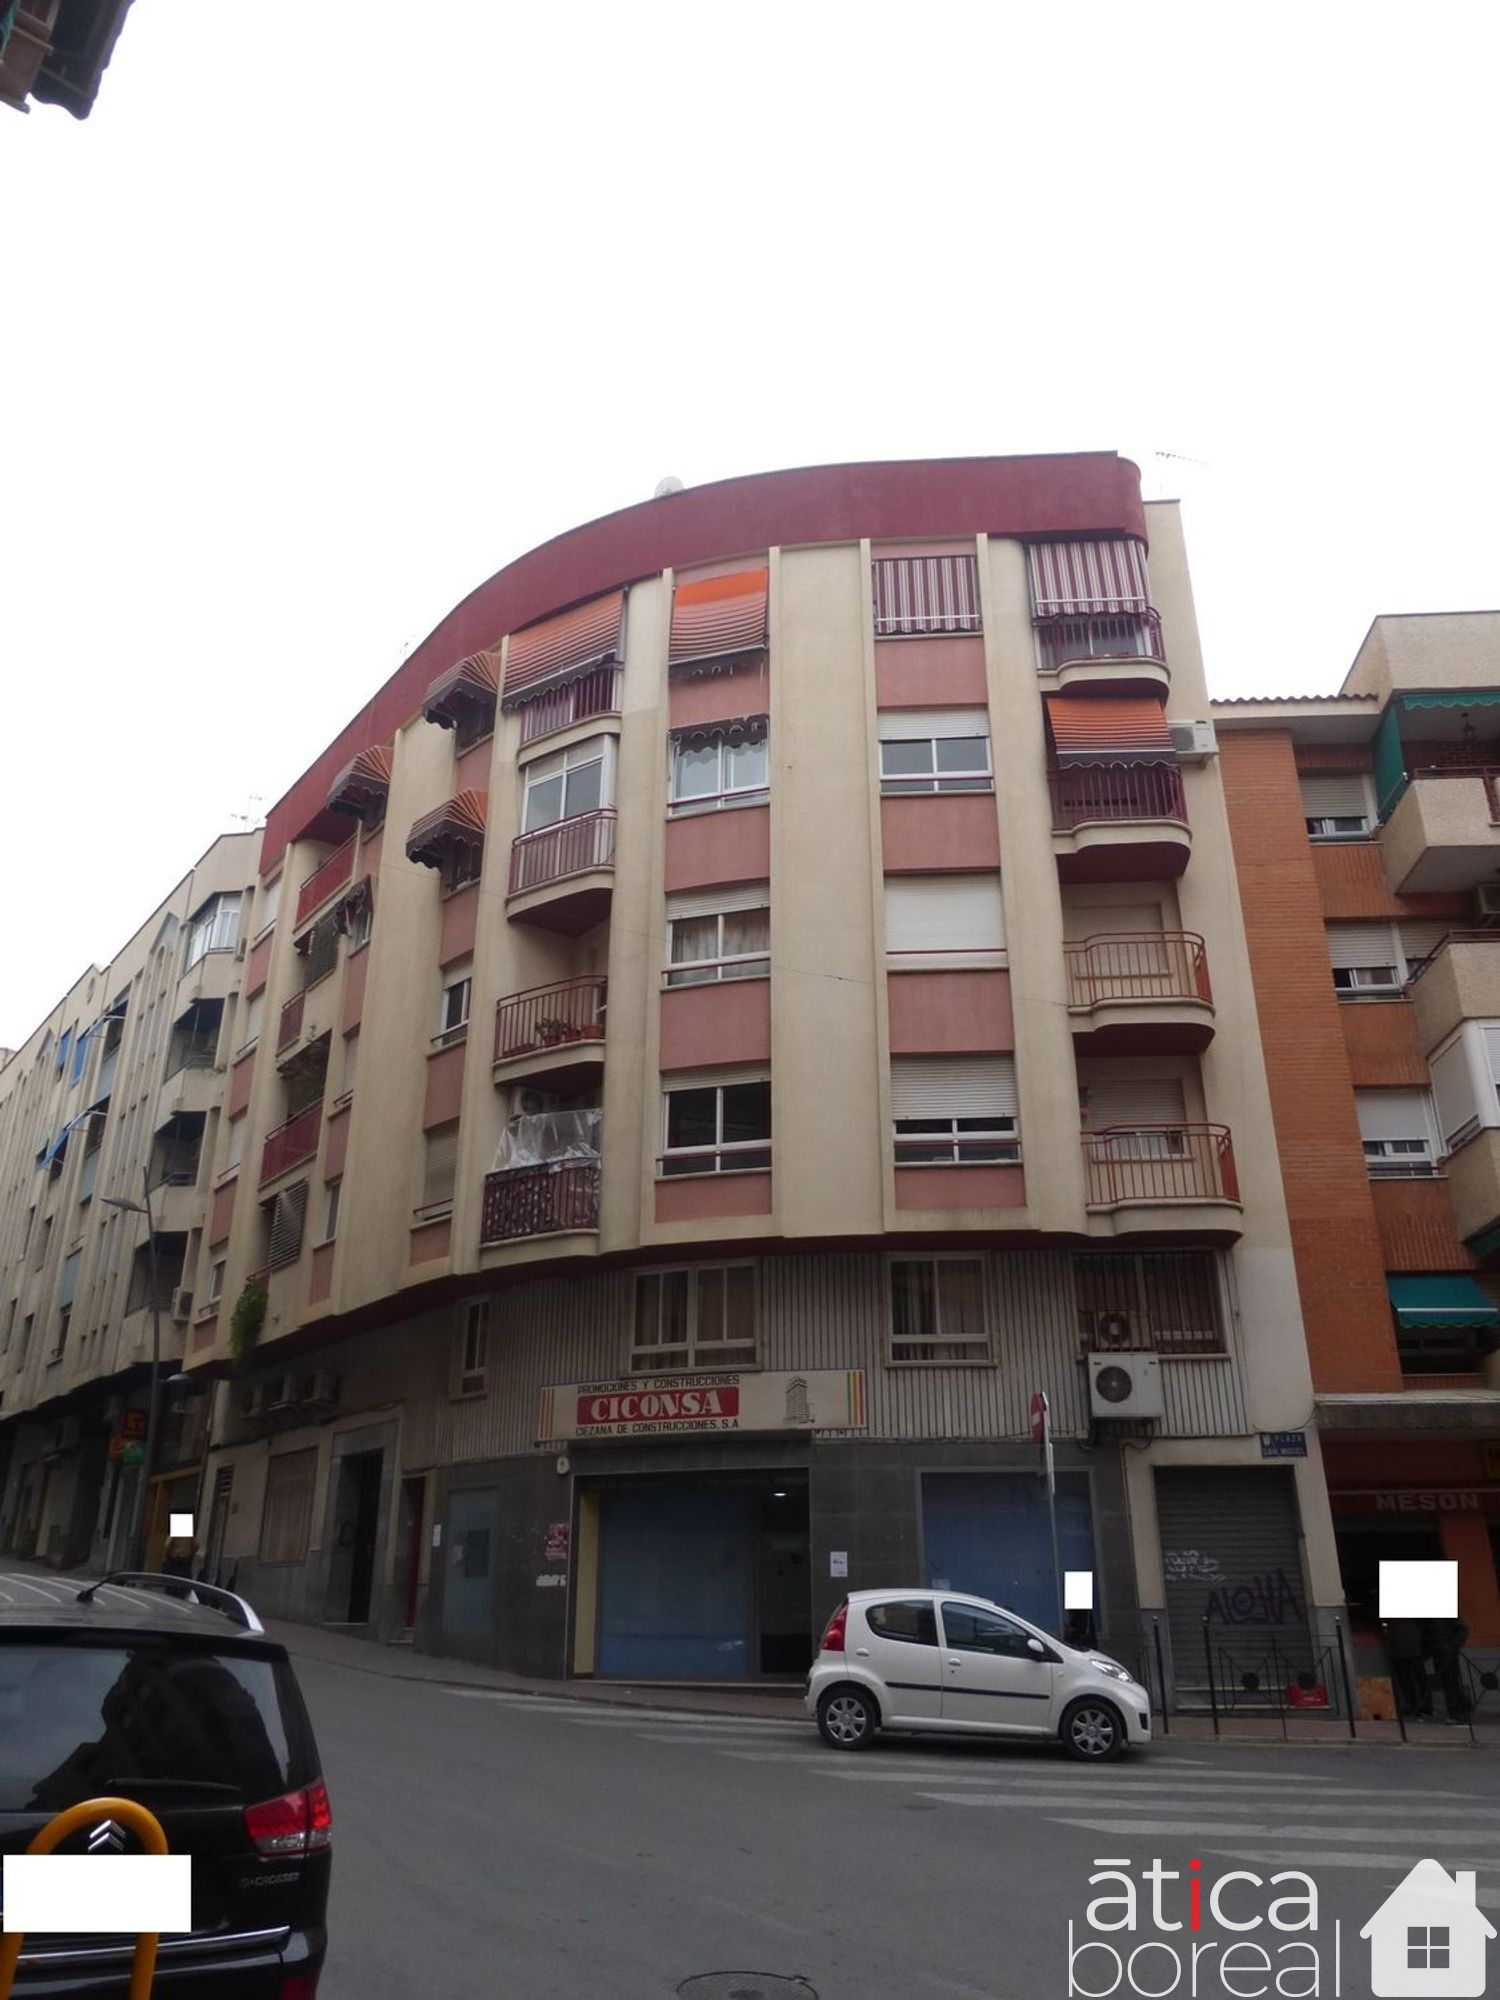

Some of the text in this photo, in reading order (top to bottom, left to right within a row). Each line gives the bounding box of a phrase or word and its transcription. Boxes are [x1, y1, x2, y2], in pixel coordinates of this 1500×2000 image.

[577, 1374, 740, 1395] PROMOCIONES Y CONSTRUCCIONES
[591, 1390, 723, 1421] CICONSA
[576, 1424, 613, 1437] CIEZANA
[617, 1423, 631, 1434] DE
[1375, 1493, 1480, 1511] MESON
